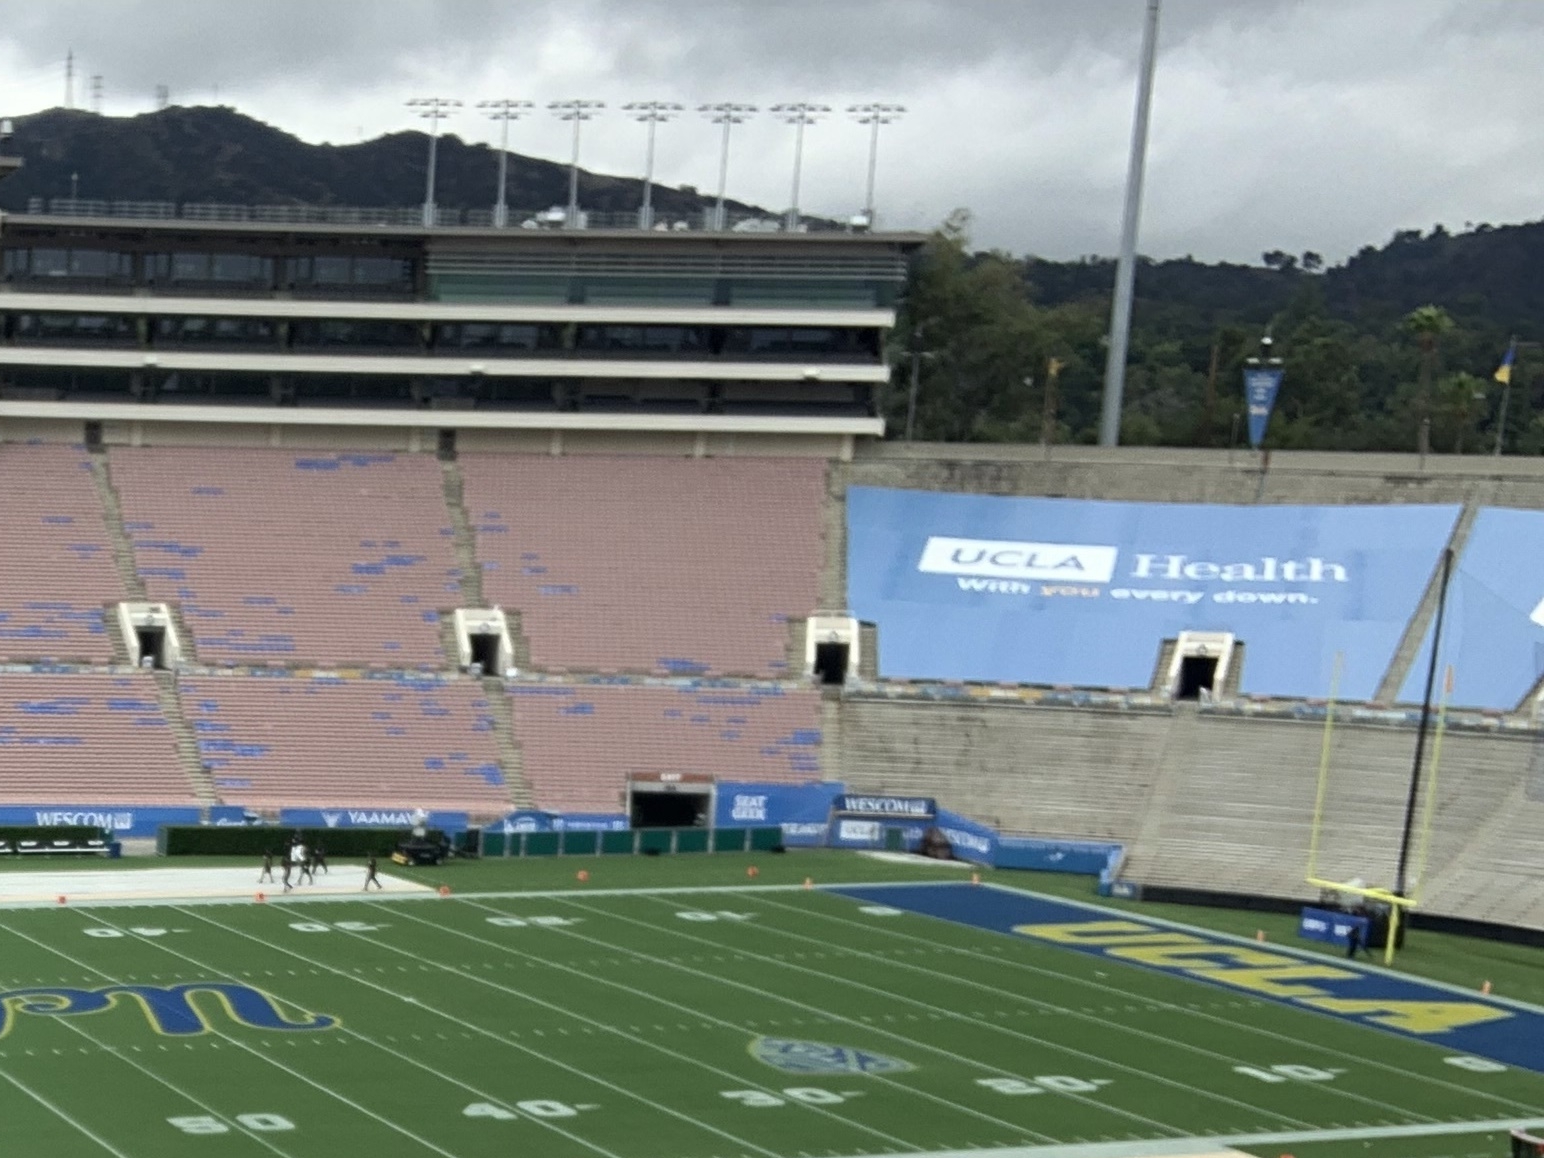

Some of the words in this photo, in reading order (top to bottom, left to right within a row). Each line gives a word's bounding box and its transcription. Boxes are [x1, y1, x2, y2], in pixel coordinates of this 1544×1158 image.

[950, 548, 1085, 572] UCLA
[1130, 554, 1349, 582] Health
[956, 577, 1030, 595] With
[1040, 585, 1100, 599] you
[1110, 588, 1204, 604] every
[733, 795, 767, 807] SEAT
[845, 797, 905, 814] WESCOM
[36, 812, 112, 828] WESCOM
[1011, 921, 1516, 1034] UCLA
[719, 1087, 845, 1107] 30
[463, 1100, 578, 1120] 40
[166, 1113, 295, 1135] 50
